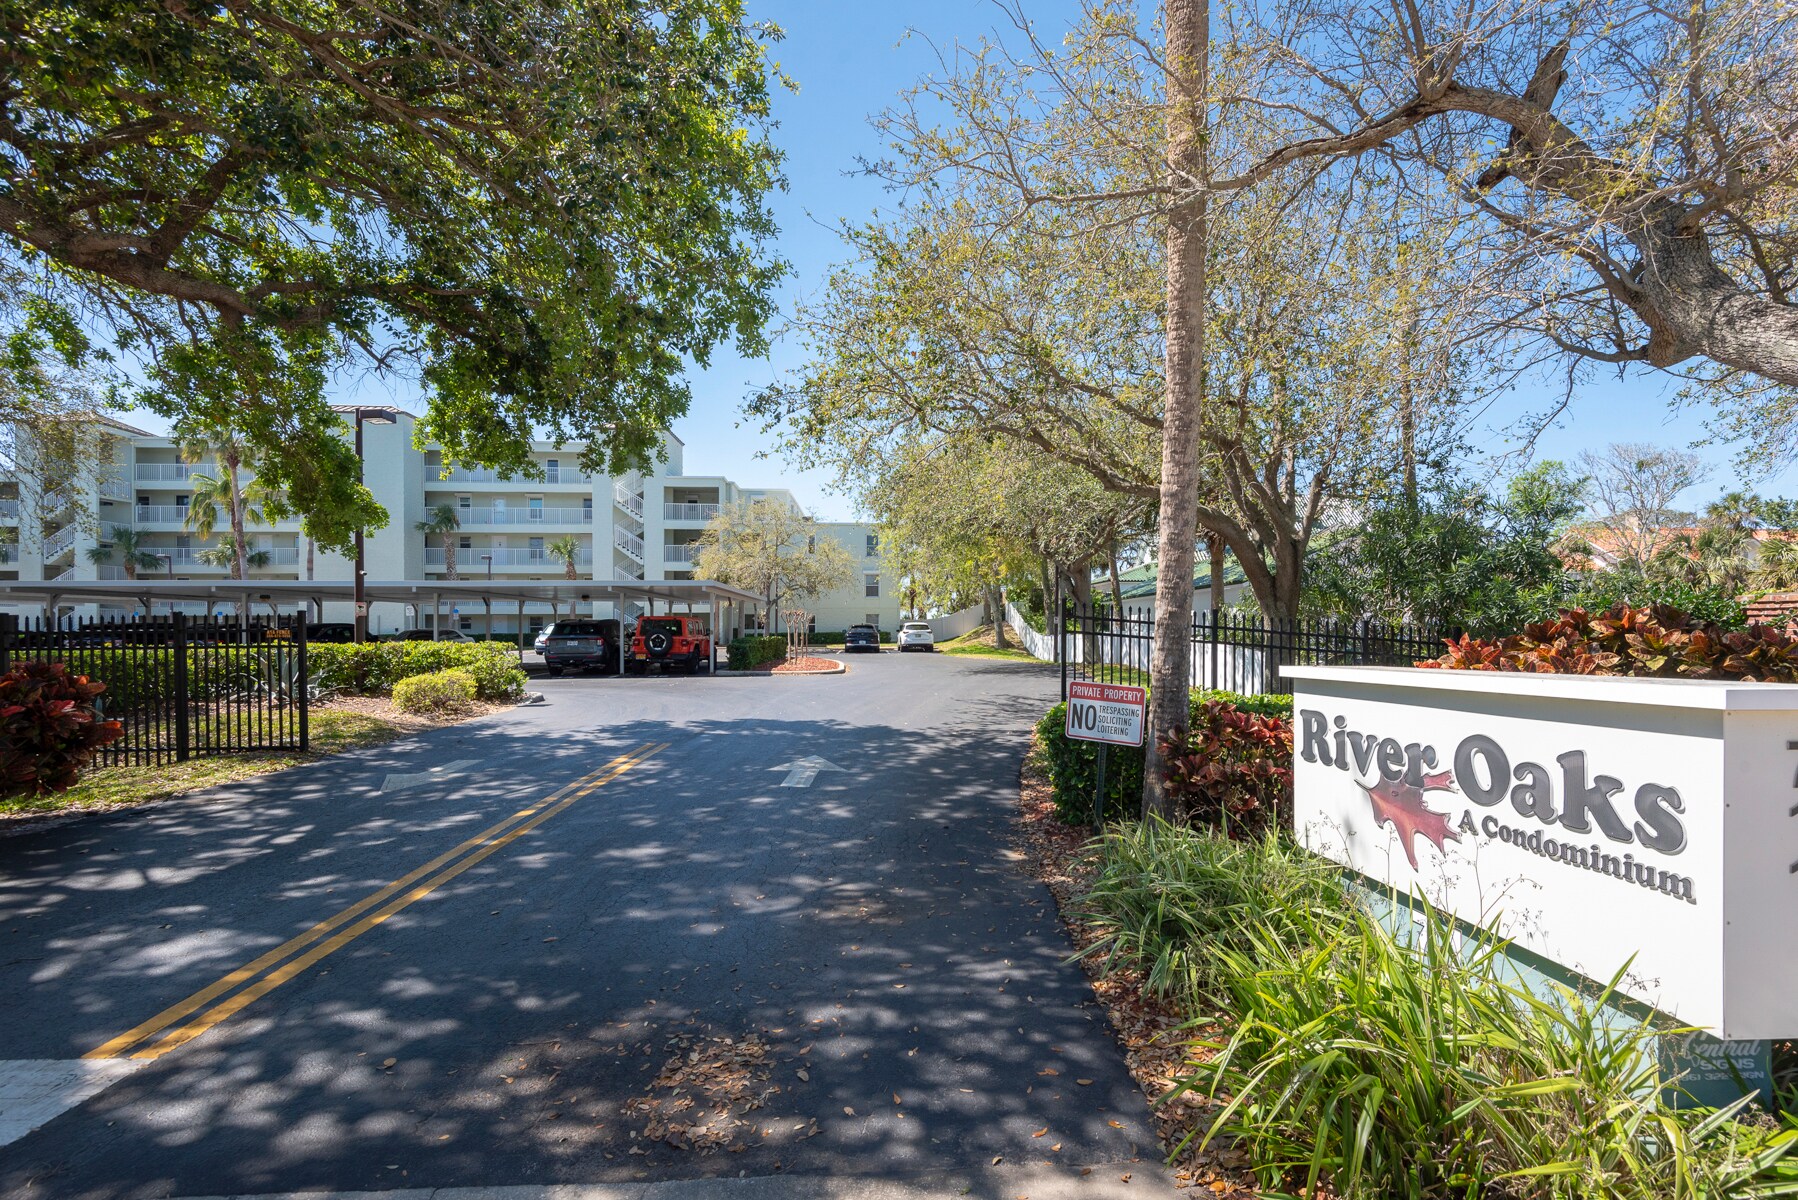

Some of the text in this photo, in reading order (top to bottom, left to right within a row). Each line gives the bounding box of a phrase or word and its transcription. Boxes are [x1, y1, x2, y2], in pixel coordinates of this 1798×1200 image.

[1072, 685, 1142, 702] PRIVATE PROPERTY
[1071, 703, 1097, 731] NO
[1099, 705, 1140, 718] TRESPASSING
[1098, 714, 1132, 727] SOLICITING
[1097, 724, 1129, 736] LOITERING
[1300, 709, 1439, 788] River
[1453, 734, 1687, 855] Oaks
[1458, 809, 1697, 905] A Condominium
[1683, 1030, 1762, 1060] Central
[1700, 1058, 1755, 1070] SIGNS
